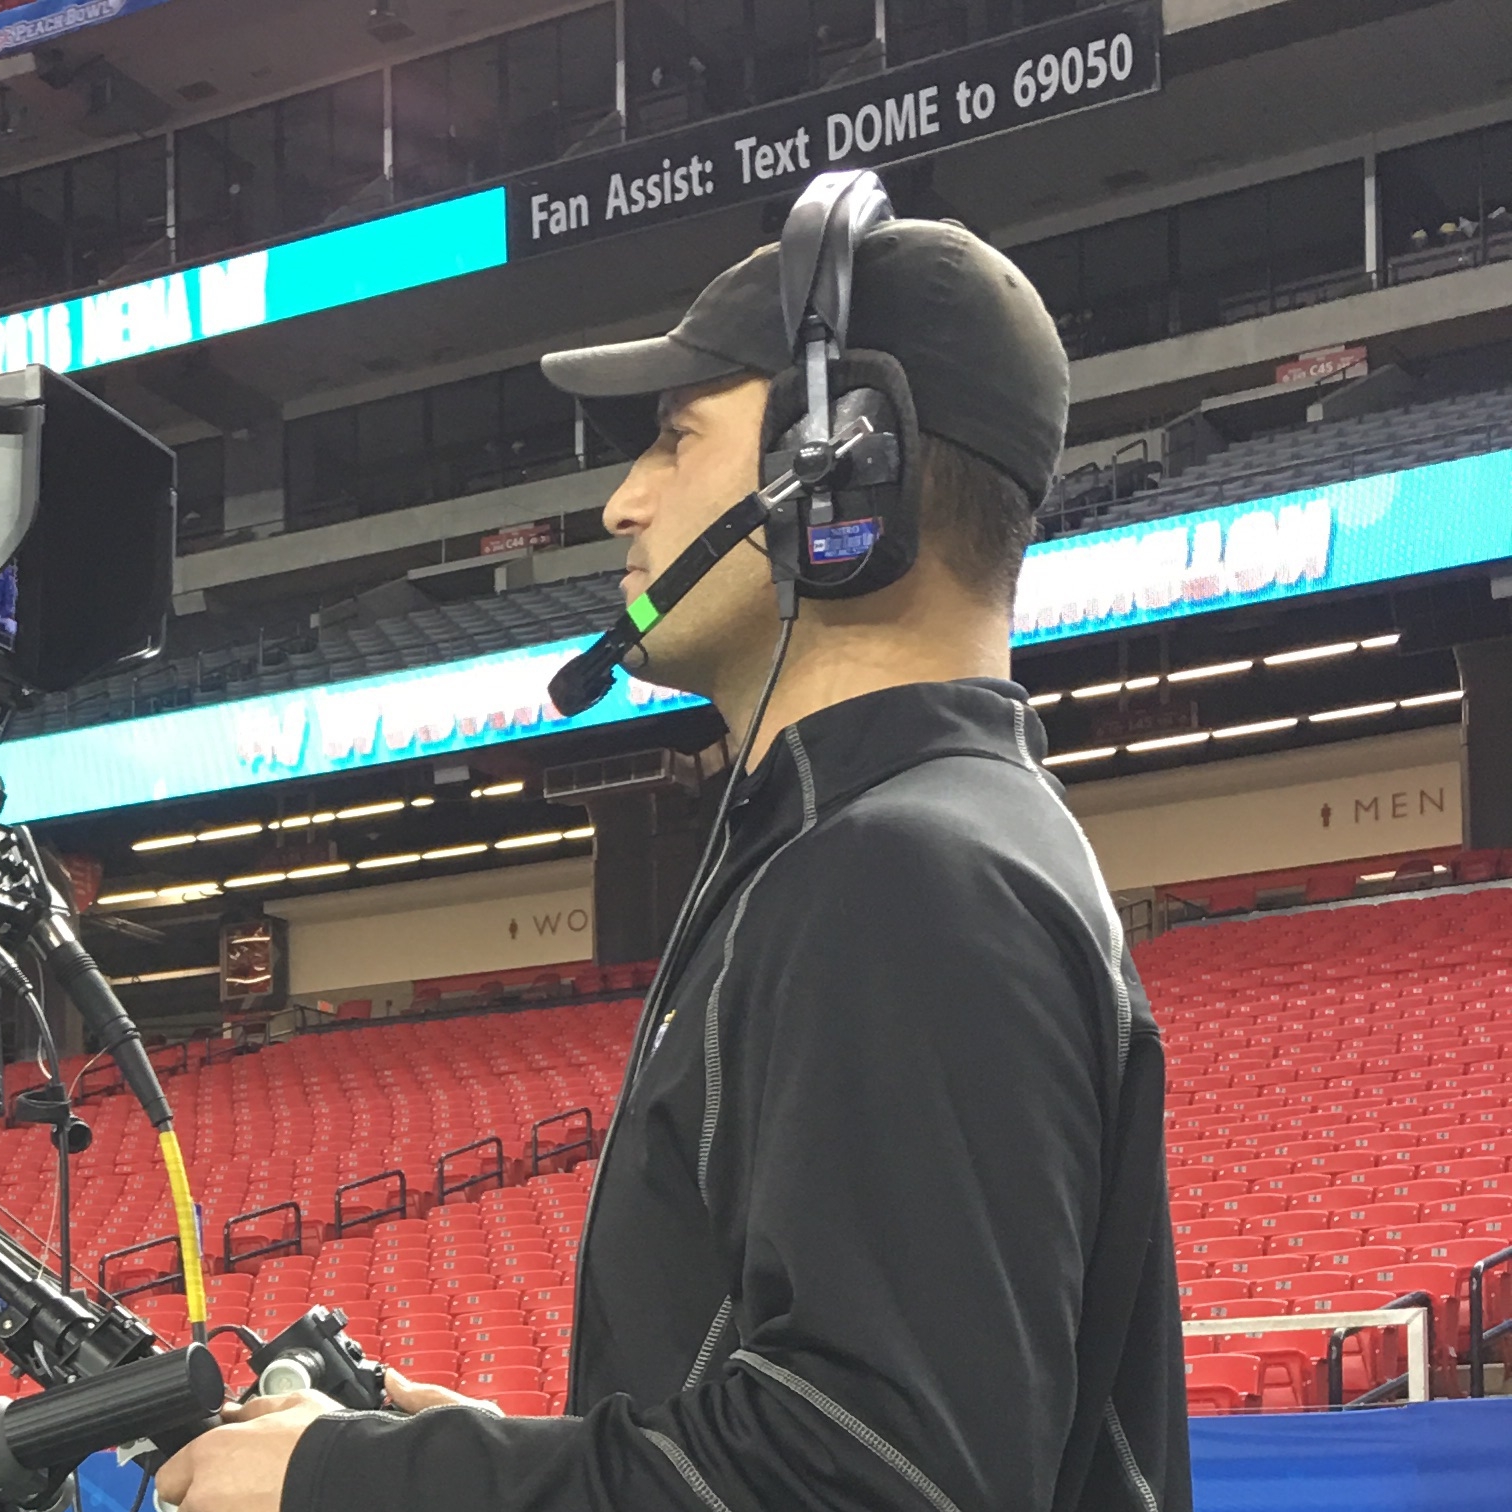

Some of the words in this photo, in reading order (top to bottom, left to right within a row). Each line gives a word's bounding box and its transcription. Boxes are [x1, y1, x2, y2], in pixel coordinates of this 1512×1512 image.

[531, 193, 589, 239] Fan
[605, 155, 714, 220] Assist:
[734, 126, 810, 184] Text
[827, 85, 940, 161] DOME
[956, 81, 996, 124] to
[1013, 33, 1134, 108] 69050
[1354, 787, 1444, 823] MEN
